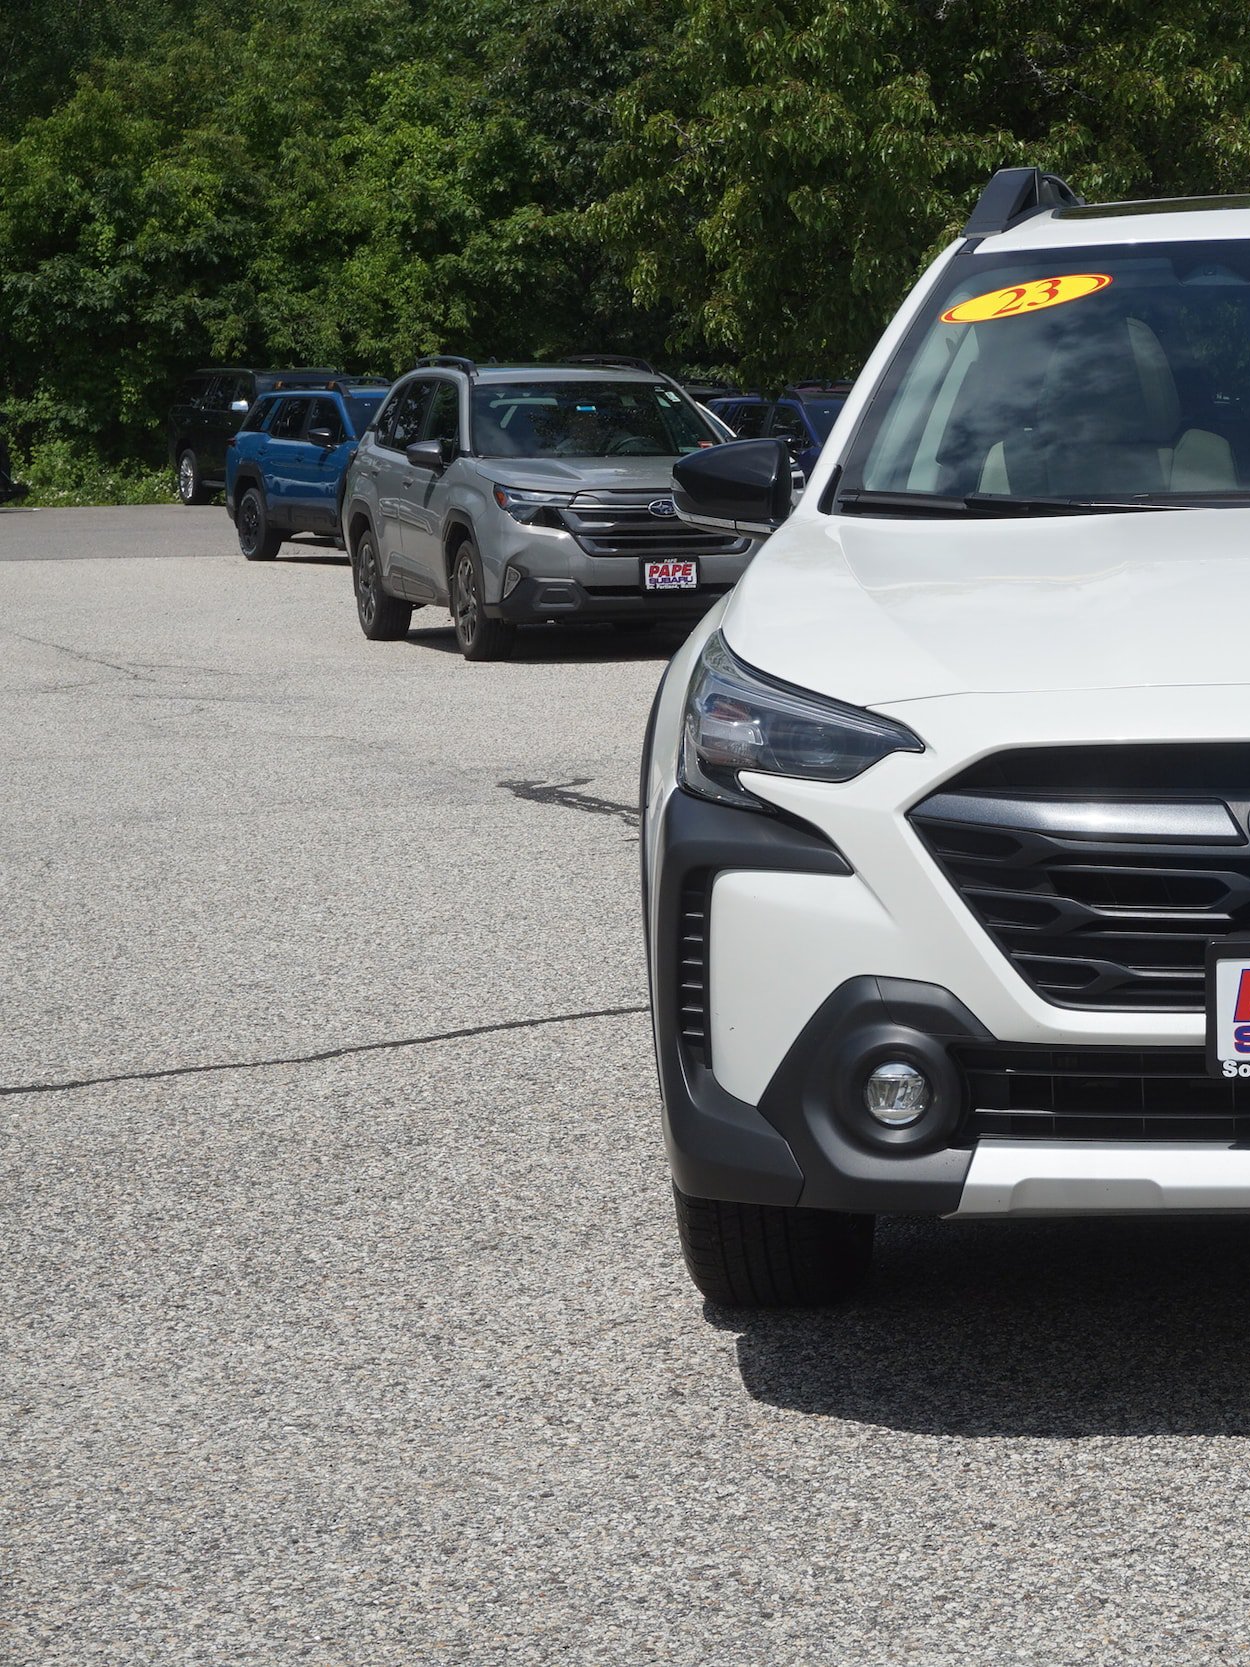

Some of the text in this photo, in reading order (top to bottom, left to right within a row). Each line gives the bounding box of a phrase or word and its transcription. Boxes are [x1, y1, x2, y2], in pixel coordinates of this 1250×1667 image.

[991, 279, 1062, 317] 23
[649, 563, 693, 577] PAPE
[649, 576, 693, 584] SUBARU
